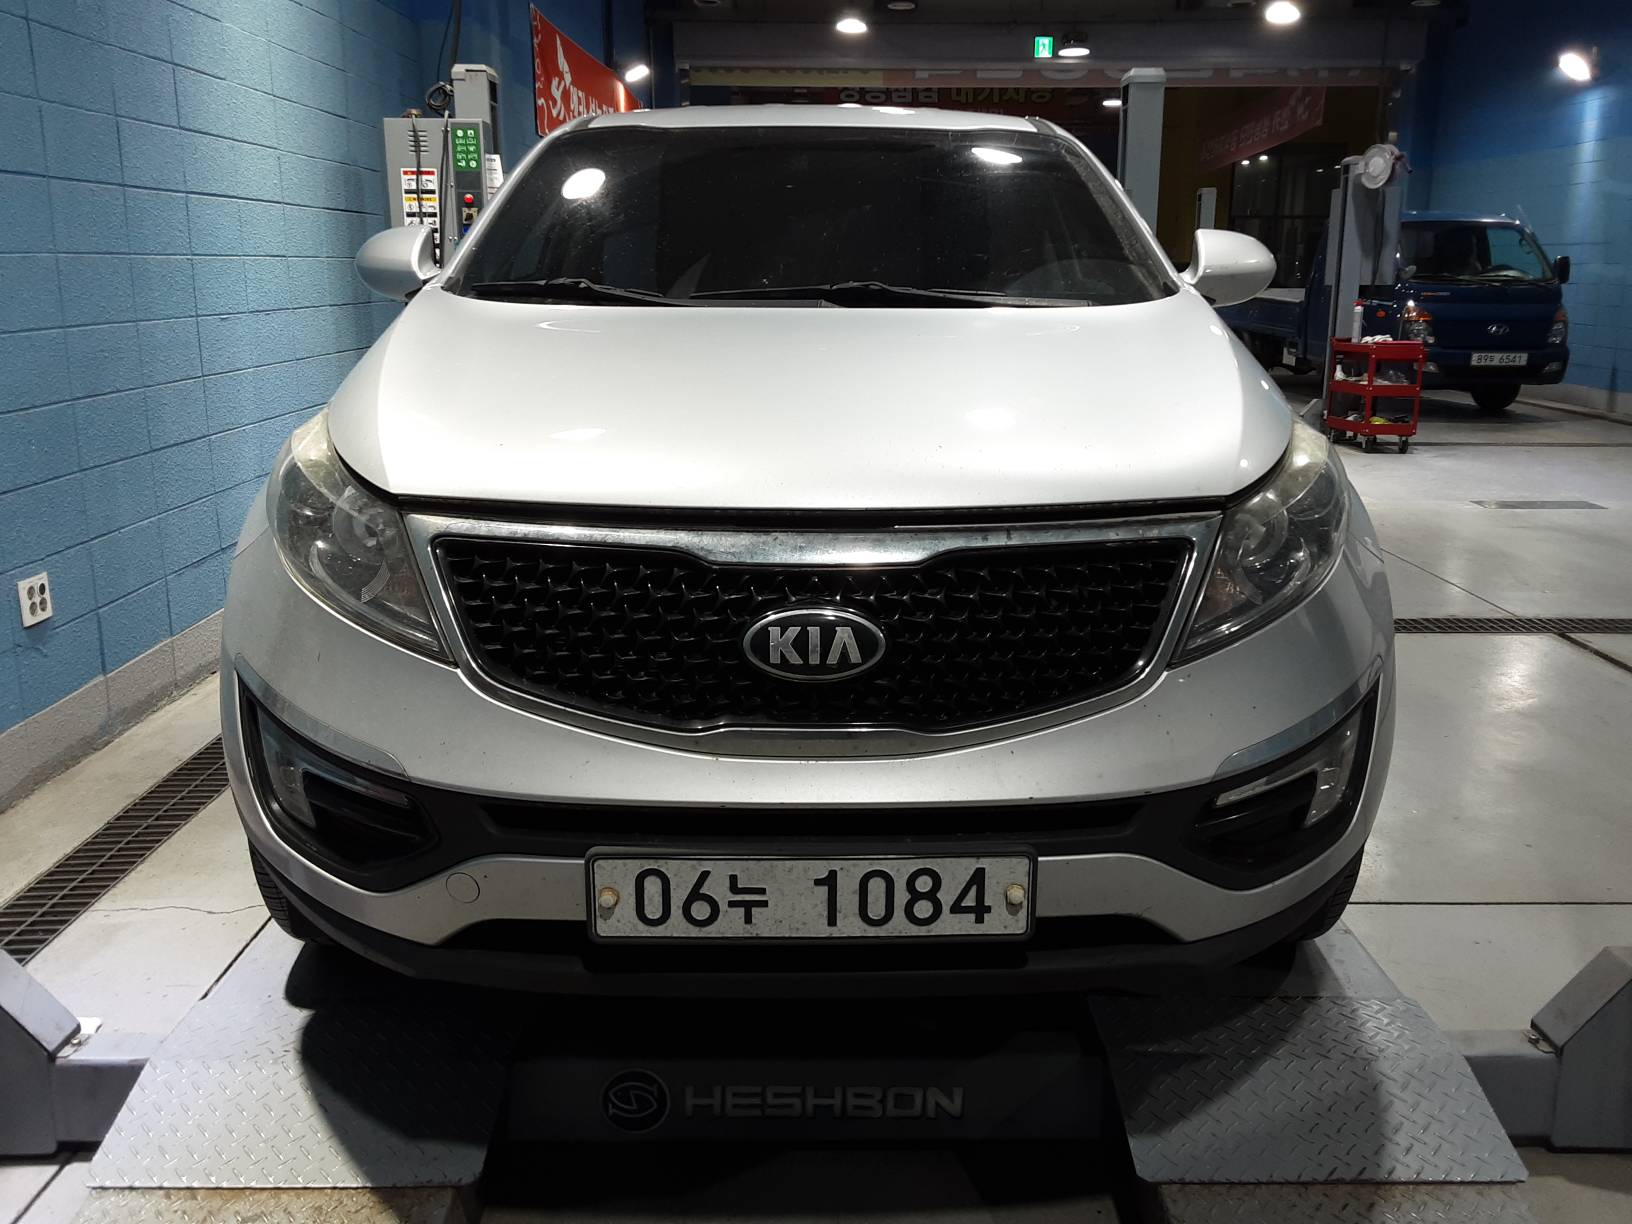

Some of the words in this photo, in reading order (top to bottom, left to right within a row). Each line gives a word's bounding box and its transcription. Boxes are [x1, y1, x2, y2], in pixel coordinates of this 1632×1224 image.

[767, 626, 863, 664] KIA
[634, 867, 769, 927] 06누
[813, 866, 992, 927] 1084
[684, 1085, 965, 1119] HESHBON
